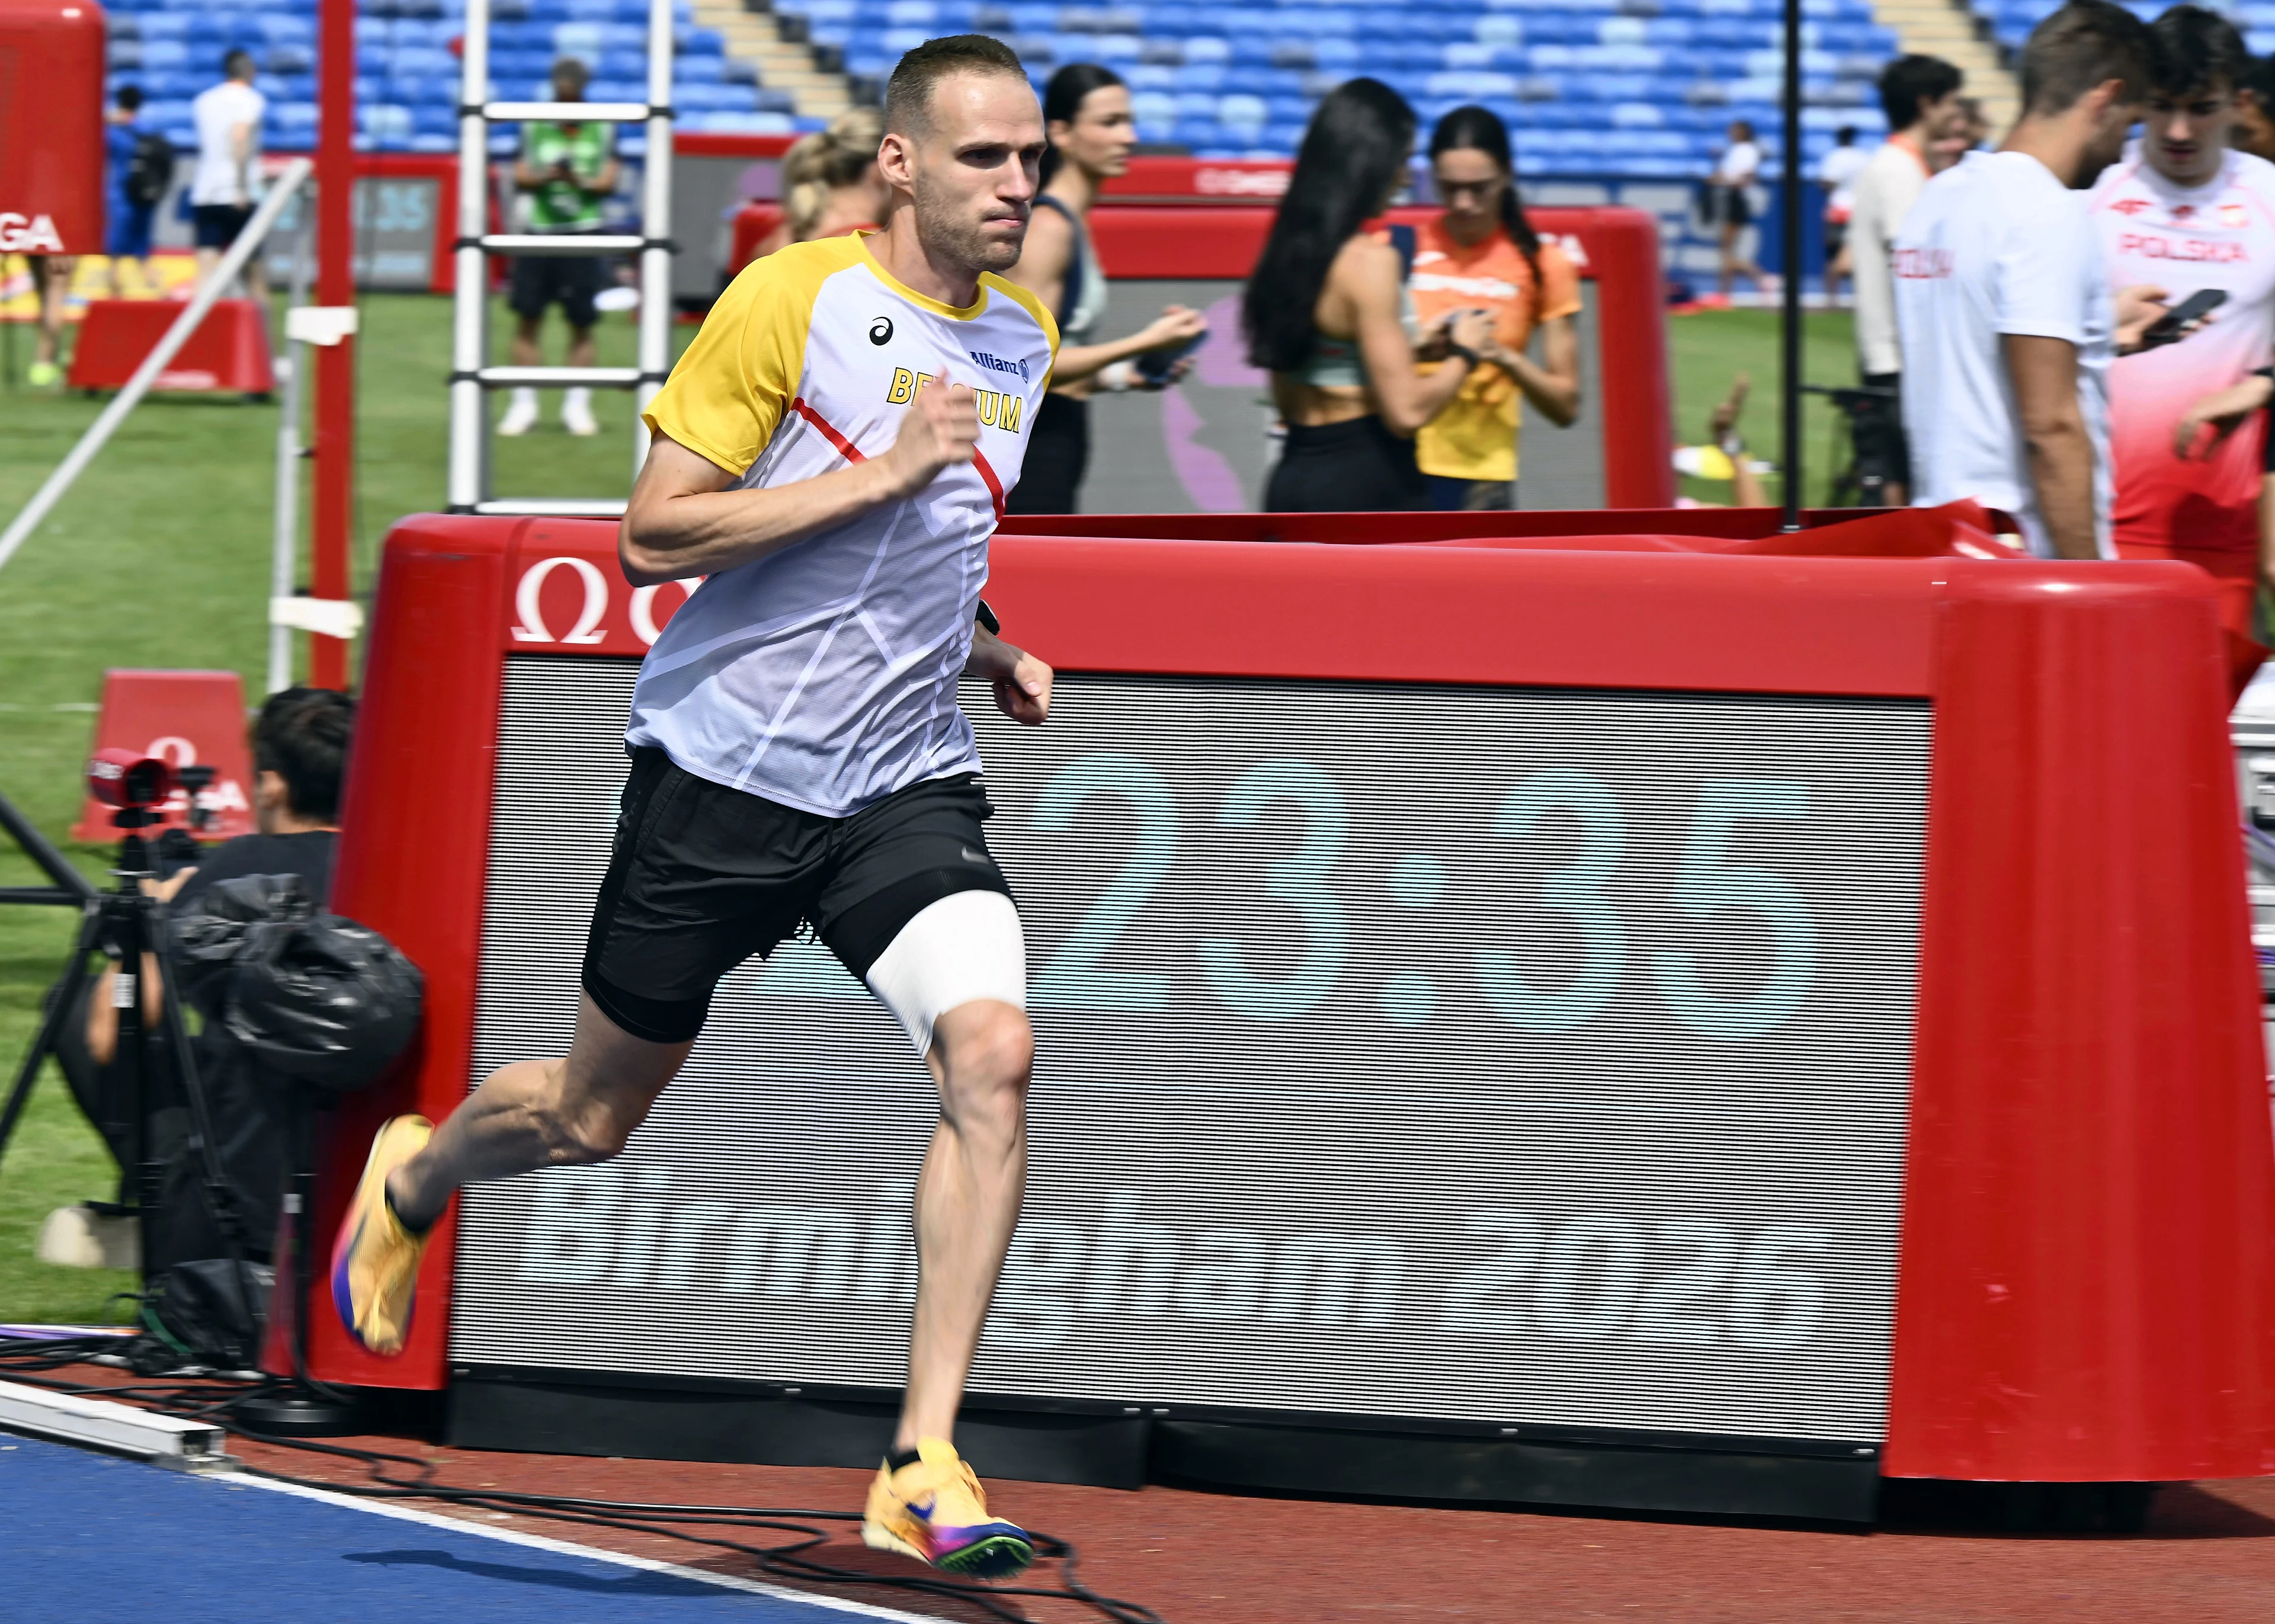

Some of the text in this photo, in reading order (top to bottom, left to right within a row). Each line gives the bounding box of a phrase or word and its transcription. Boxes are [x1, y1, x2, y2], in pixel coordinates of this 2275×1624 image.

[970, 351, 1019, 375] Allianz
[519, 1159, 1831, 1353] Birmigham 2026
